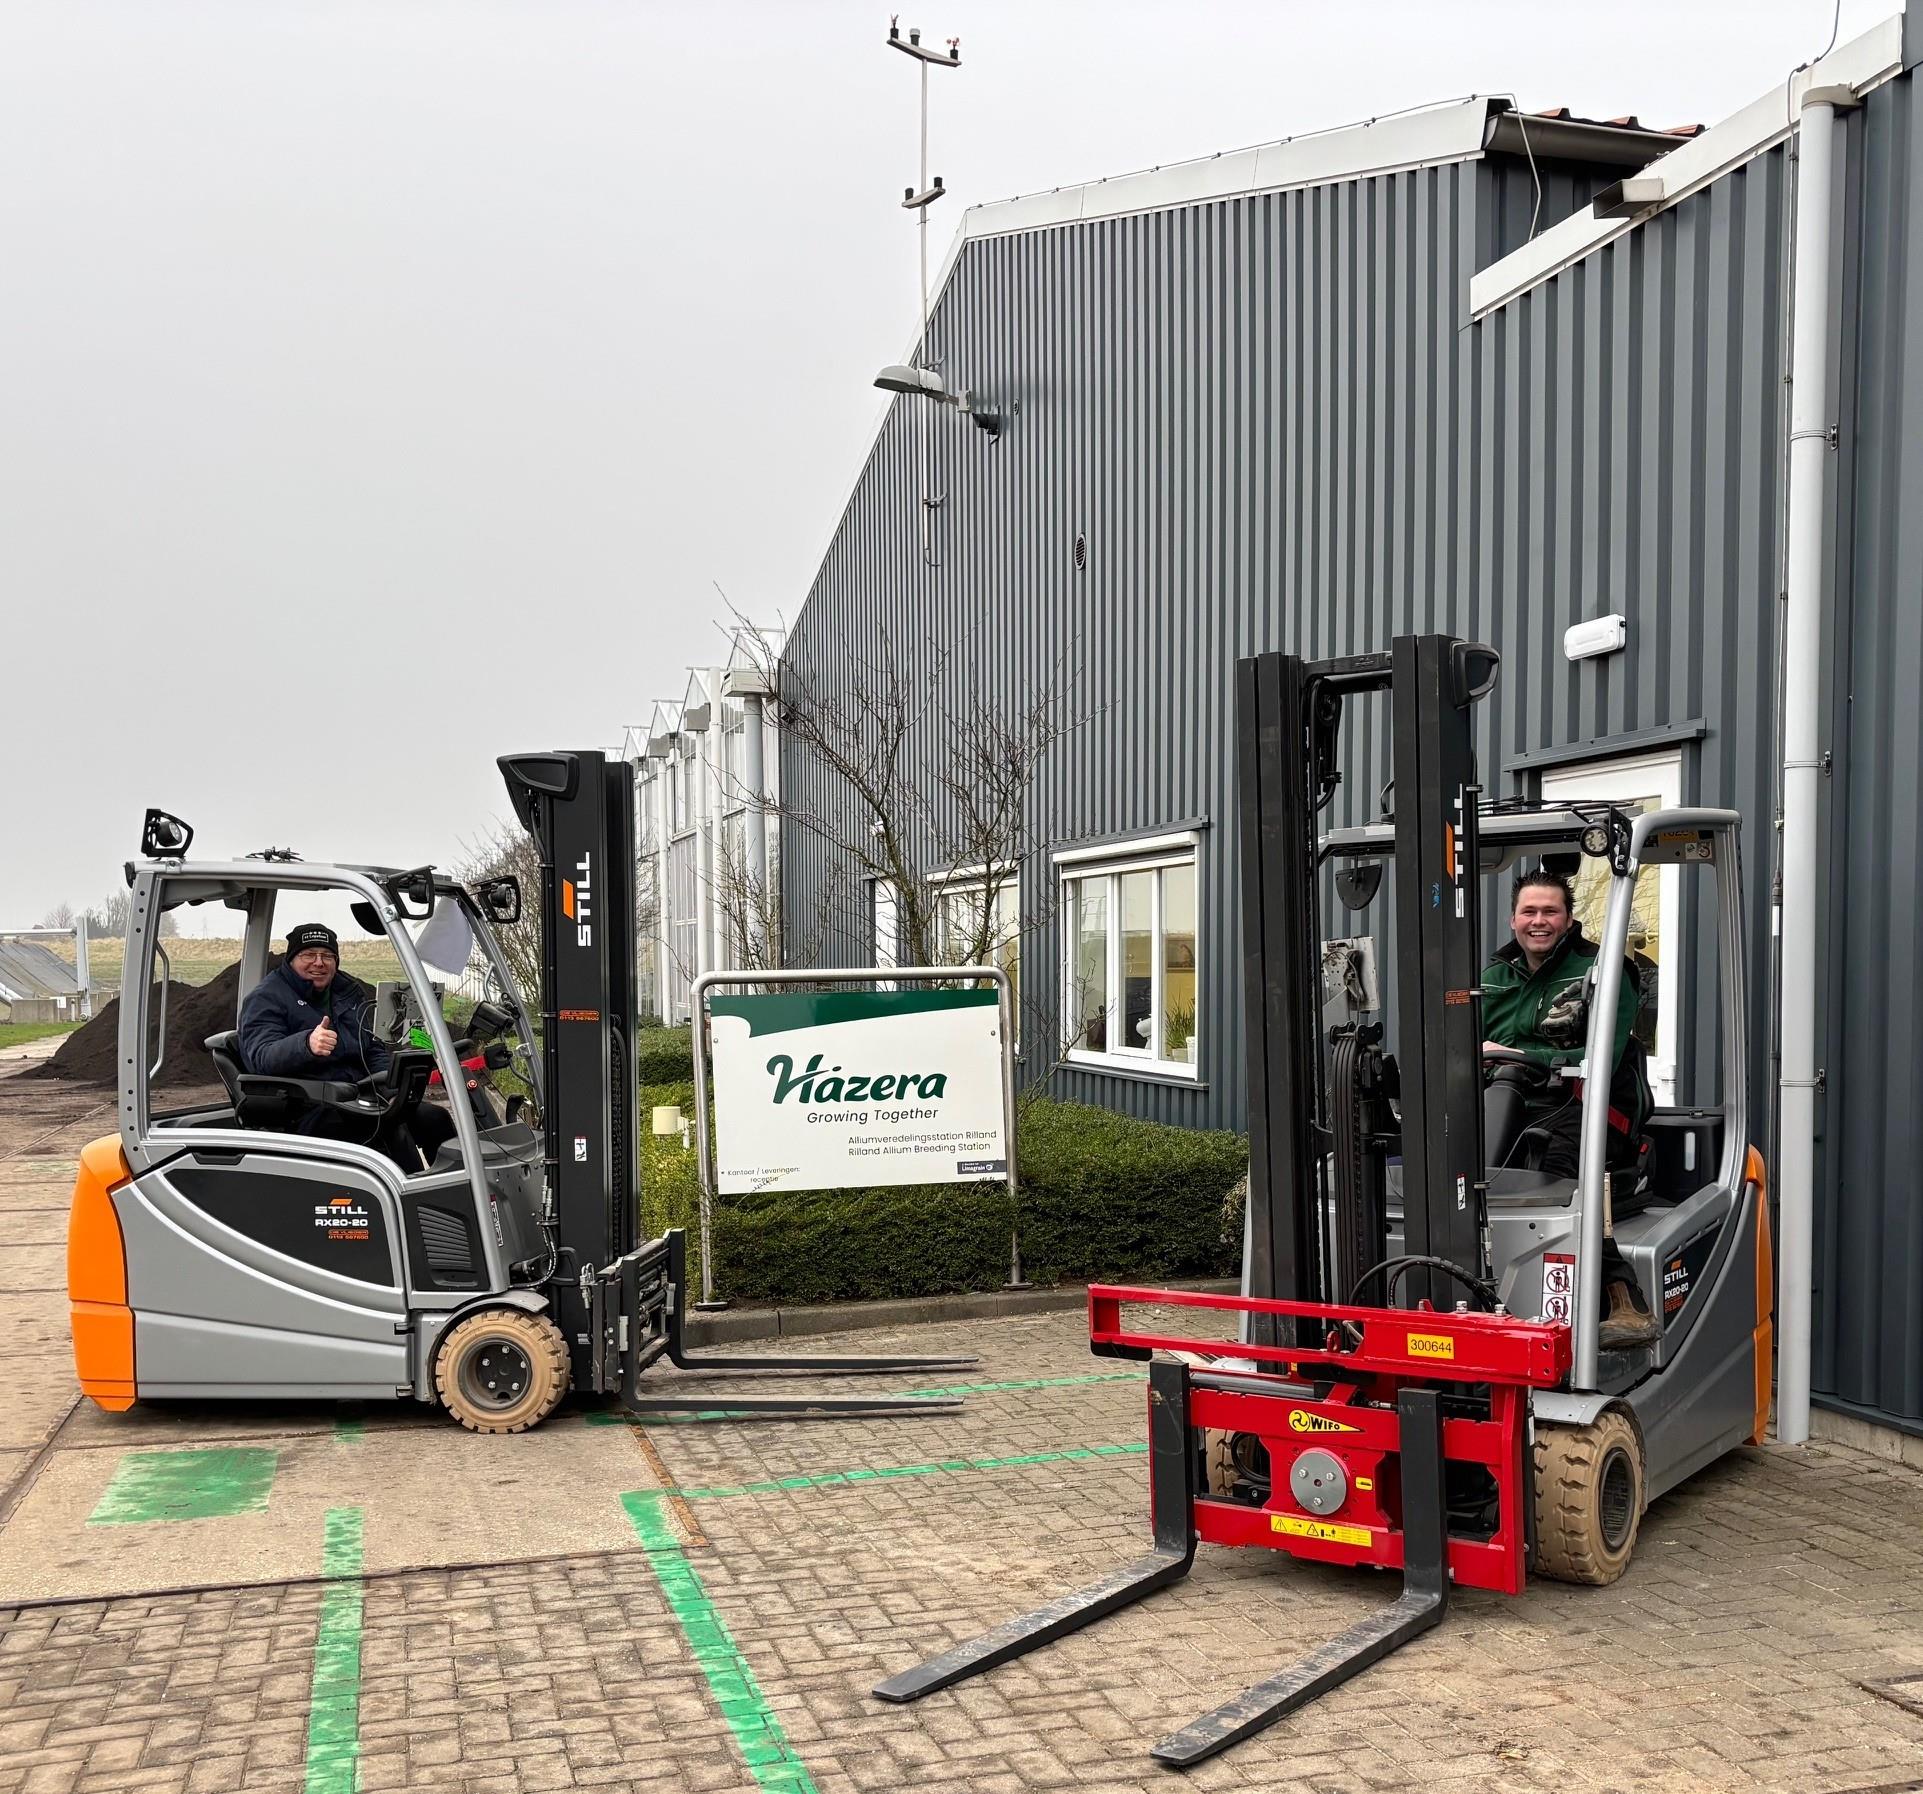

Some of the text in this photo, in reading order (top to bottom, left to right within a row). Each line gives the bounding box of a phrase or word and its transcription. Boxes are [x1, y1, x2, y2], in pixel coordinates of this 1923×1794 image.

[1454, 783, 1464, 918] STILL
[576, 851, 592, 947] STILL
[806, 1107, 939, 1125] Growing Together
[848, 1130, 997, 1145] Alliumveredelingsstation Rilland
[848, 1141, 991, 1156] Rilland Allium Breeding Station
[314, 1205, 369, 1215] STILL
[314, 1218, 369, 1228] RX20-20
[1664, 1267, 1689, 1285] STILL
[1664, 1282, 1689, 1301] RX20-20
[1410, 1338, 1452, 1354] 300644
